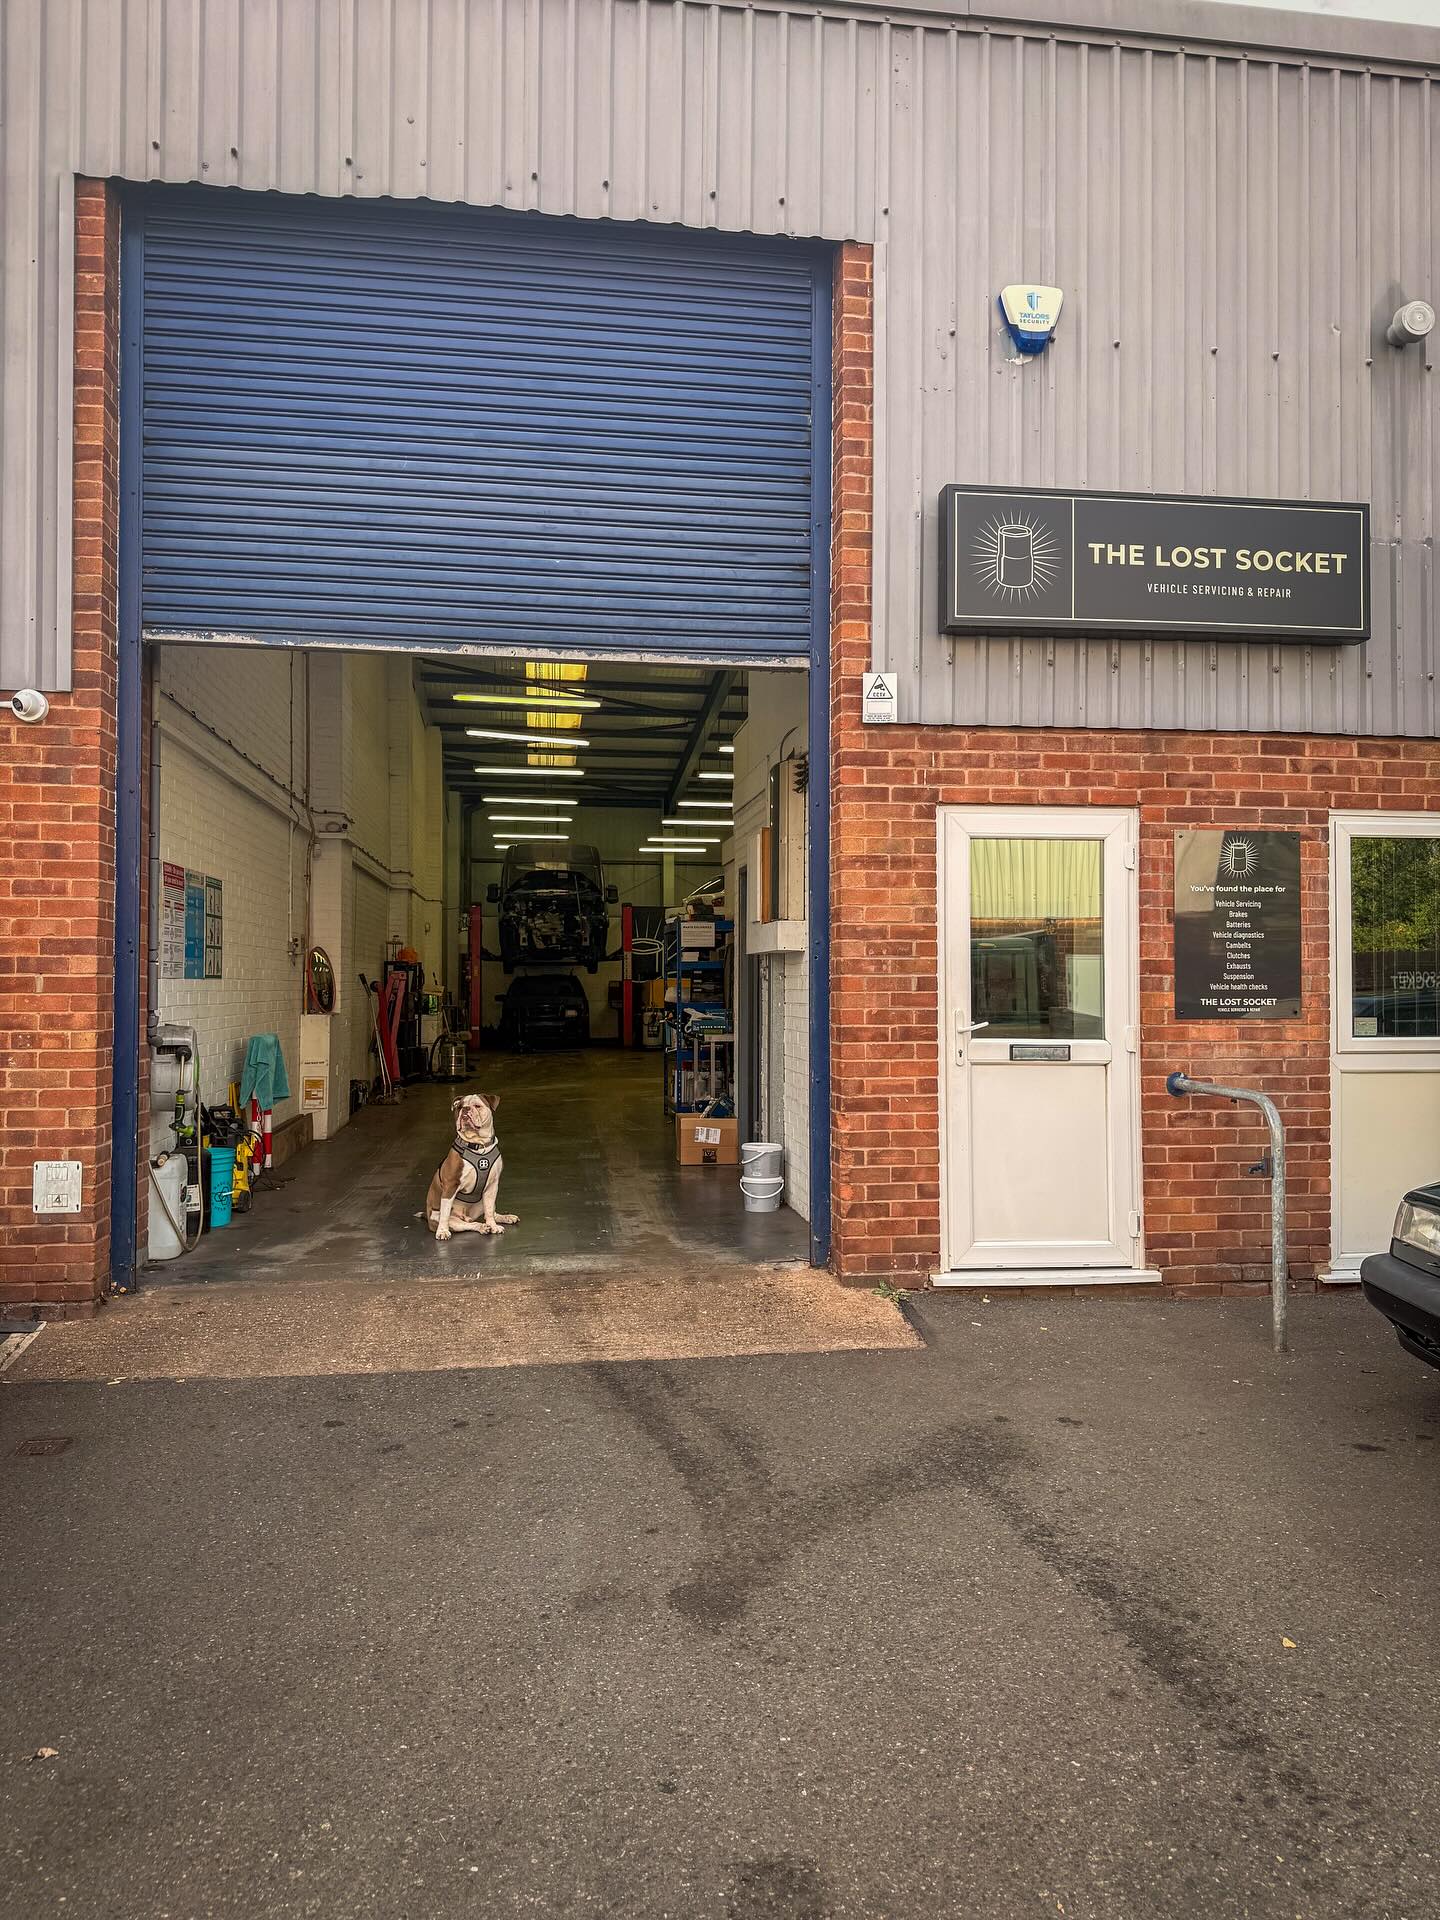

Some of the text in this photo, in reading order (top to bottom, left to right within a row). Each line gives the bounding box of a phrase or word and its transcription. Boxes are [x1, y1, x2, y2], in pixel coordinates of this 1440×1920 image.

[1020, 312, 1050, 320] TAYLORS
[1088, 543, 1348, 574] THE LOST SOCKET
[1147, 583, 1292, 598] VEHICLE SERVICING & REPAIR
[1254, 885, 1274, 893] place
[1275, 885, 1286, 893] for
[1215, 900, 1261, 908] Vehicle Servicing
[1213, 931, 1264, 940] Vehicle diagnostics
[1226, 962, 1251, 970] Exhausts
[1223, 973, 1255, 981] Suspension
[1200, 998, 1277, 1006] THE LOST SOCKET
